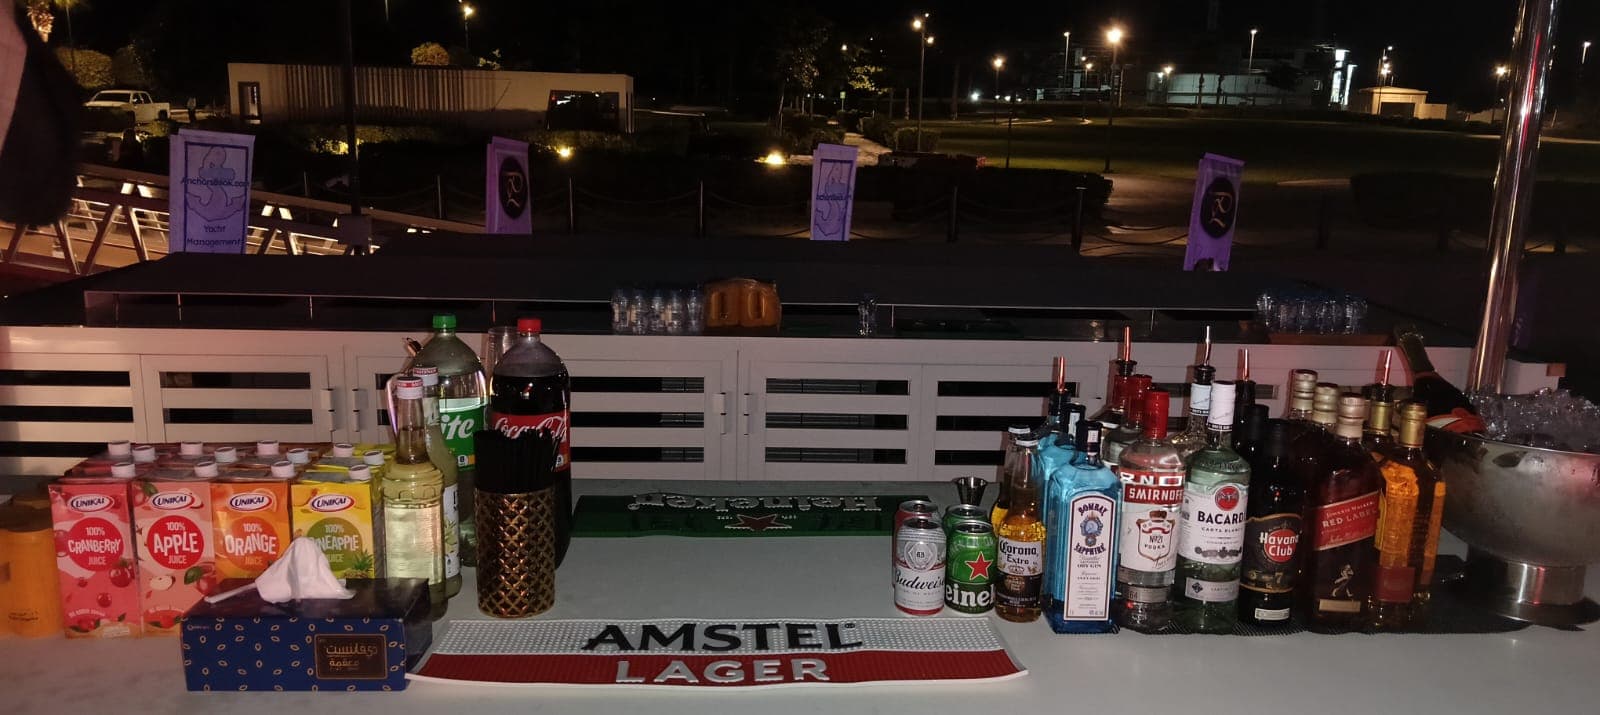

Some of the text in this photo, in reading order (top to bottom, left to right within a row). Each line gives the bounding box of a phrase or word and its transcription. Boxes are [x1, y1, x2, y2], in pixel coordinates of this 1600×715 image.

[204, 224, 226, 234] Yacht
[187, 238, 241, 248] Management
[440, 414, 475, 440] ite
[76, 497, 105, 508] UNIKAI
[157, 496, 187, 506] UNIKAI
[234, 497, 265, 507] UNIKAI
[316, 497, 347, 508] UNIKAI
[628, 494, 882, 512] Heineken
[1078, 503, 1108, 516] BOMBAY
[1322, 508, 1377, 529] RED LABEL
[86, 527, 105, 536] 100%
[167, 522, 186, 531] 100%
[243, 523, 263, 532] 100%
[325, 524, 345, 533] 100%
[1259, 532, 1299, 544] Havana
[68, 539, 121, 554] CRANBERRY
[153, 532, 199, 556] APPLE
[224, 534, 277, 556] ORANGE
[1074, 542, 1107, 555] SAPPHIRE
[1268, 545, 1293, 557] Club
[88, 556, 106, 565] JUICE
[168, 555, 187, 564] JUICE
[245, 556, 263, 566] JUICE
[1007, 554, 1029, 565] Extra
[616, 658, 830, 683] LAGER
